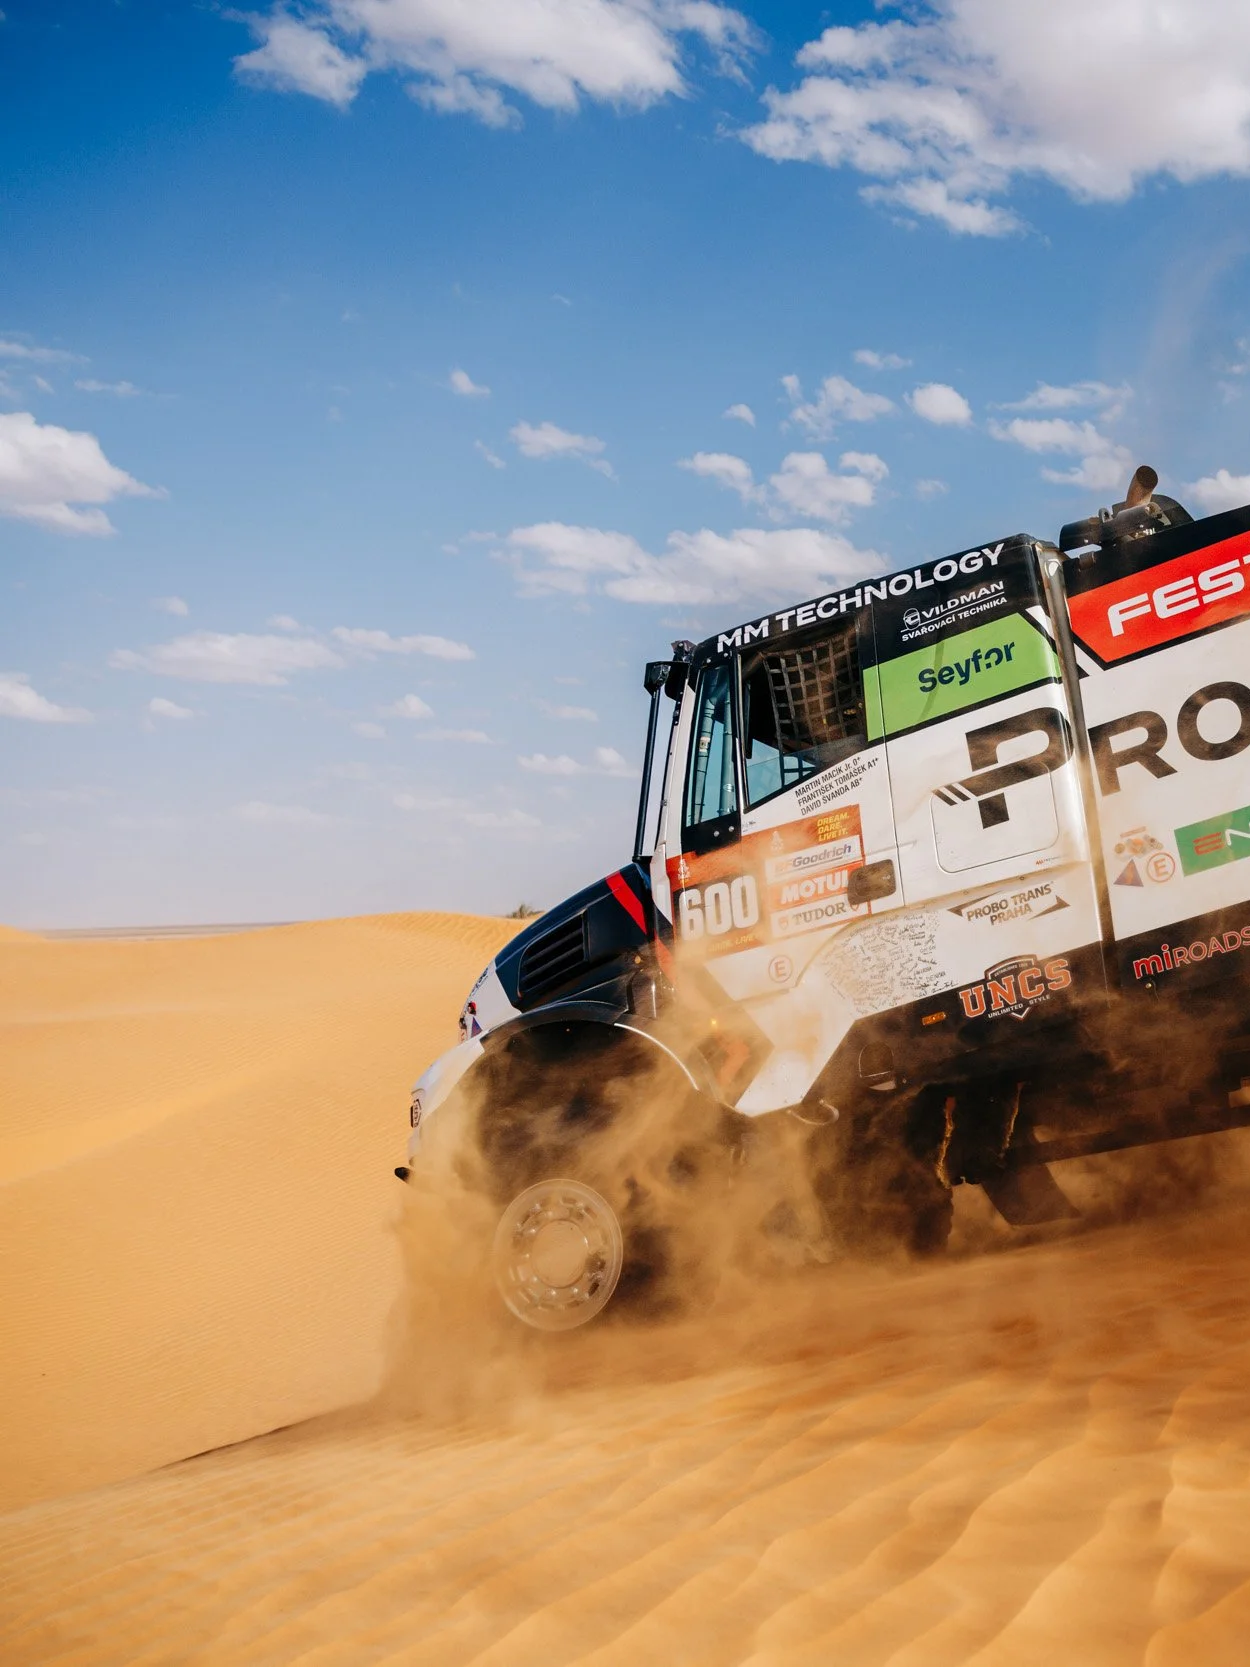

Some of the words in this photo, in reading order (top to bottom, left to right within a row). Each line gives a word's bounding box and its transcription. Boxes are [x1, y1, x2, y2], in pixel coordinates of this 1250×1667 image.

[717, 619, 769, 653] MM
[776, 543, 1005, 633] TECHNOLOGY
[922, 581, 1004, 618] VILDMAN
[957, 597, 1008, 620] TECHNIKA
[794, 779, 821, 798] MARTIN
[845, 764, 853, 772] Jr.
[797, 781, 835, 807] FRANTIŠEK
[800, 799, 822, 816] DAVID
[822, 785, 850, 804] ŠVANDA
[817, 812, 850, 827] DREAM.
[818, 822, 843, 835] DARE.
[818, 830, 838, 842] LIVE
[679, 874, 759, 942] 600
[792, 902, 846, 925] TUDOR
[966, 898, 1008, 922] PROBO
[1010, 883, 1052, 906] TRANS
[989, 903, 1034, 926] PRAHA
[959, 958, 1072, 1018] UNCS
[988, 1003, 1024, 1019] UNLIMITED
[1029, 994, 1051, 1006] STYLE
